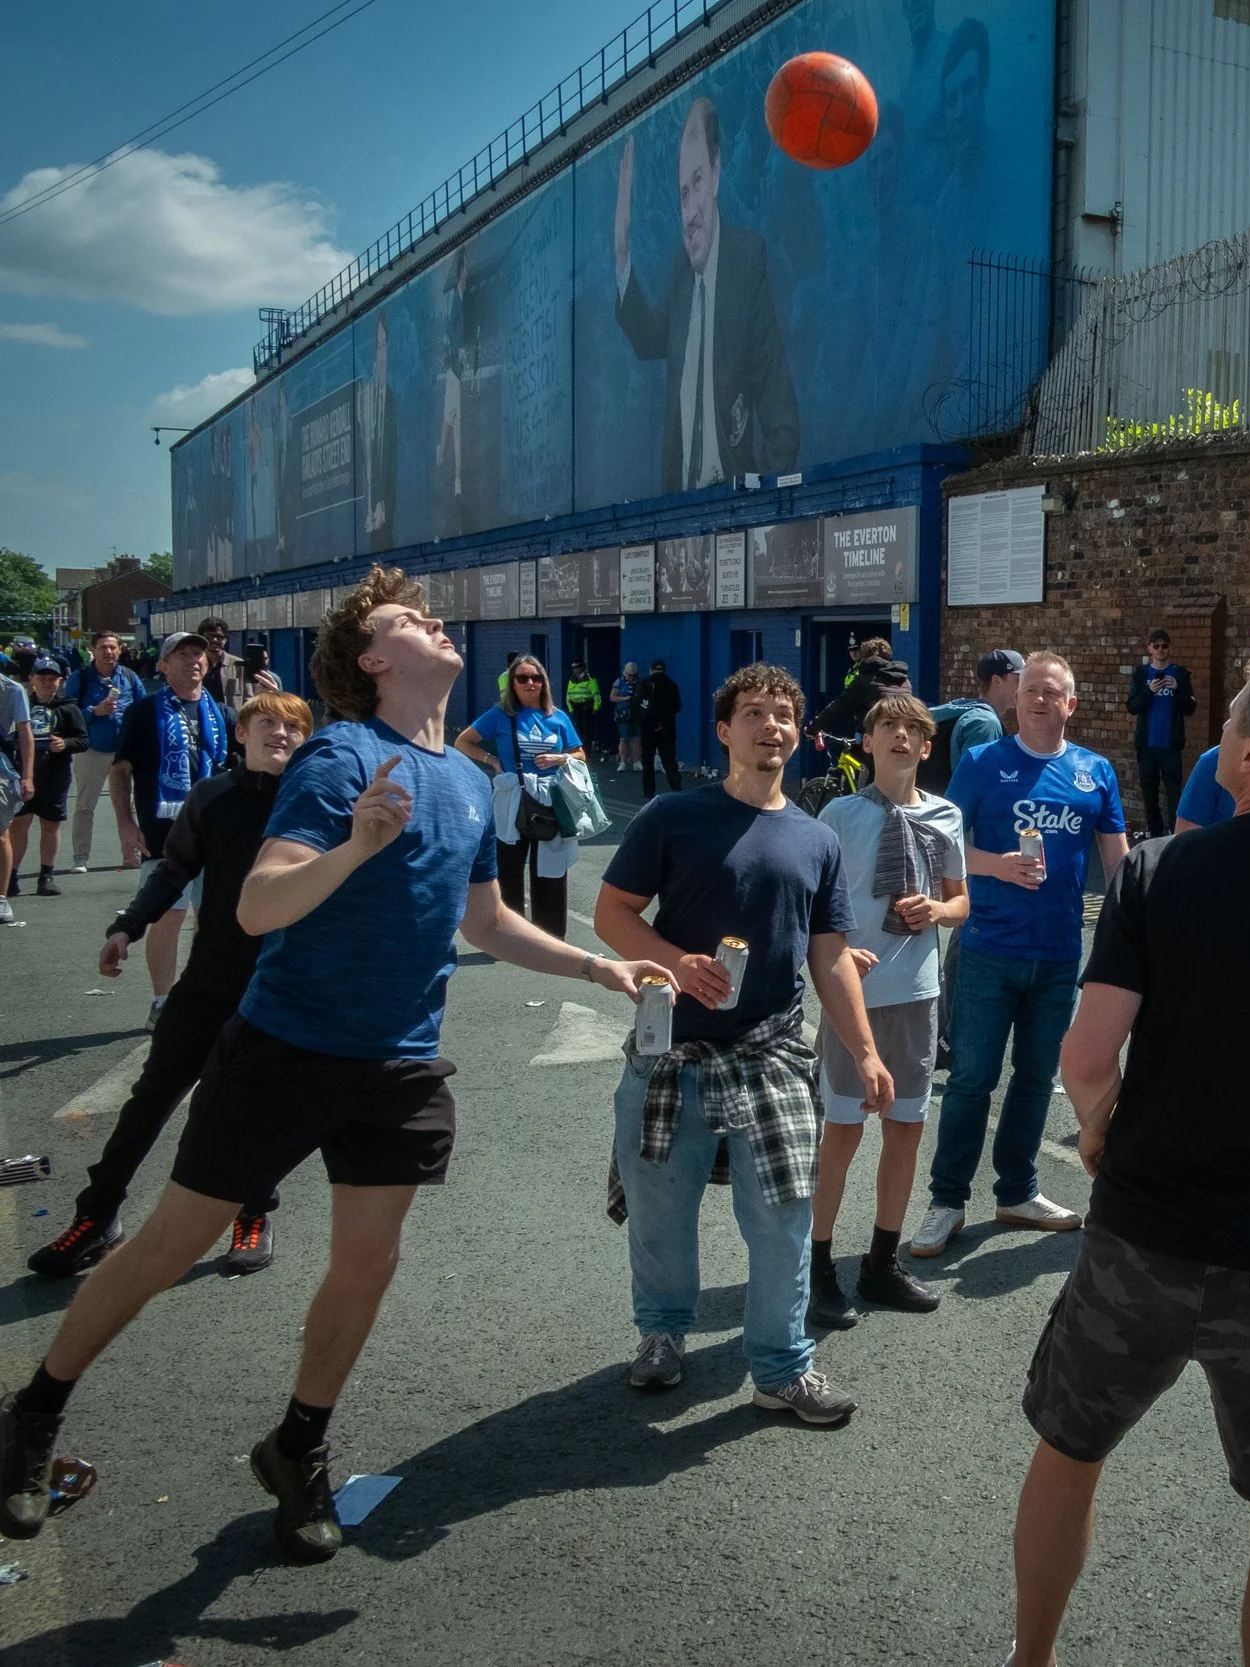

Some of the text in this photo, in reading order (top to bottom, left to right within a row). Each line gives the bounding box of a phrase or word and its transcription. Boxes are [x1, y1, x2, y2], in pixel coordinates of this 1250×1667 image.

[834, 525, 897, 548] THE EVERTON
[843, 547, 885, 568] TIMELINE
[1013, 799, 1083, 835] Stake
